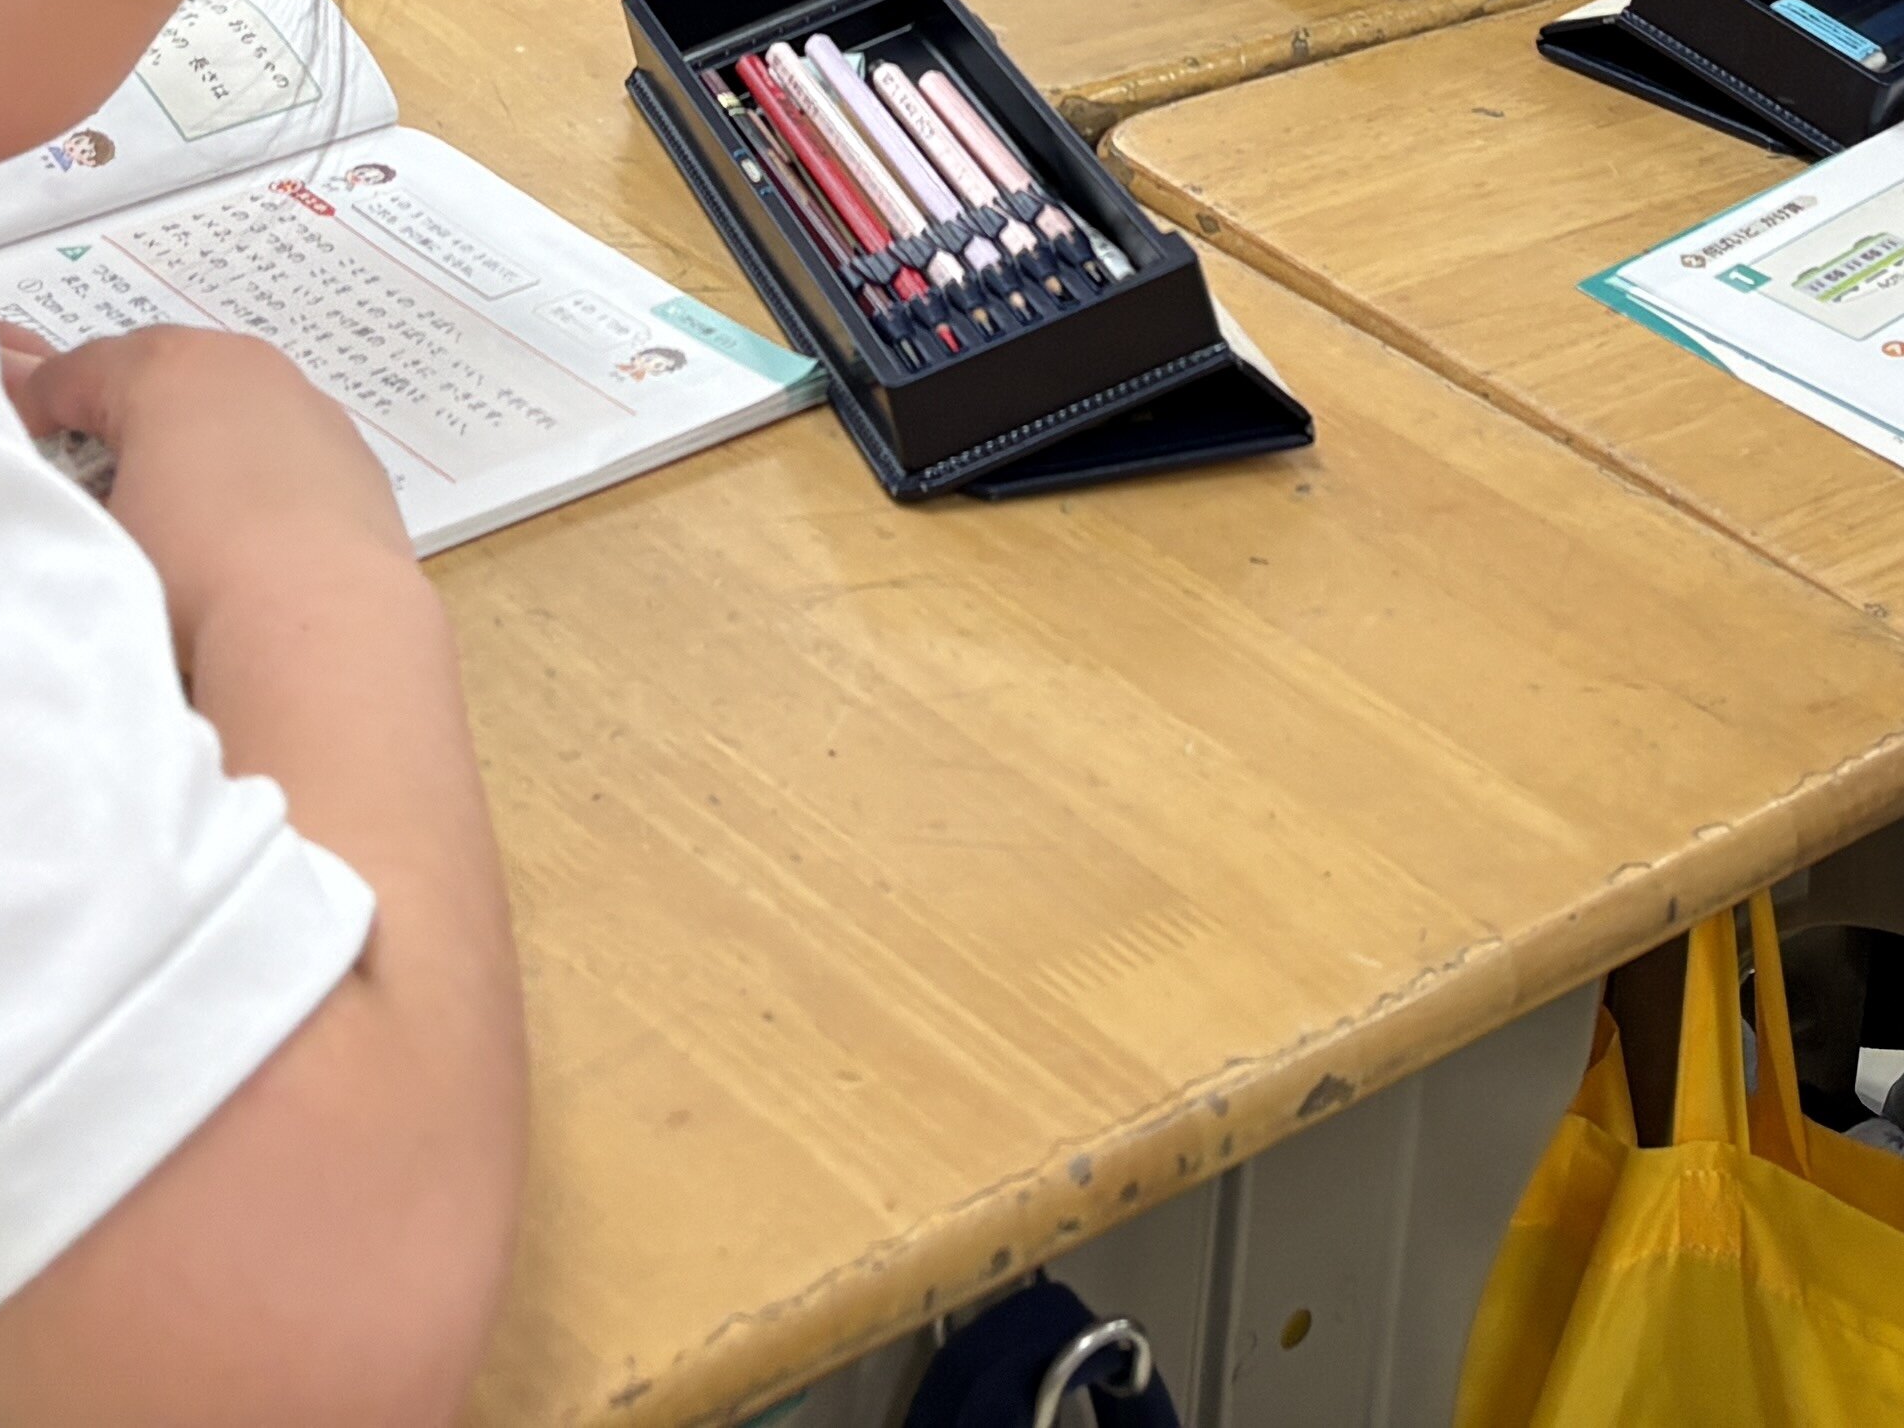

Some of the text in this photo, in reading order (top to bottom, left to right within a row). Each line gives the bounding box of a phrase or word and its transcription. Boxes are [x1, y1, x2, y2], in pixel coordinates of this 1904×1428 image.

[225, 17, 295, 90] おもちゃの
[185, 54, 235, 100] 長さは
[1725, 269, 1761, 287] 1
